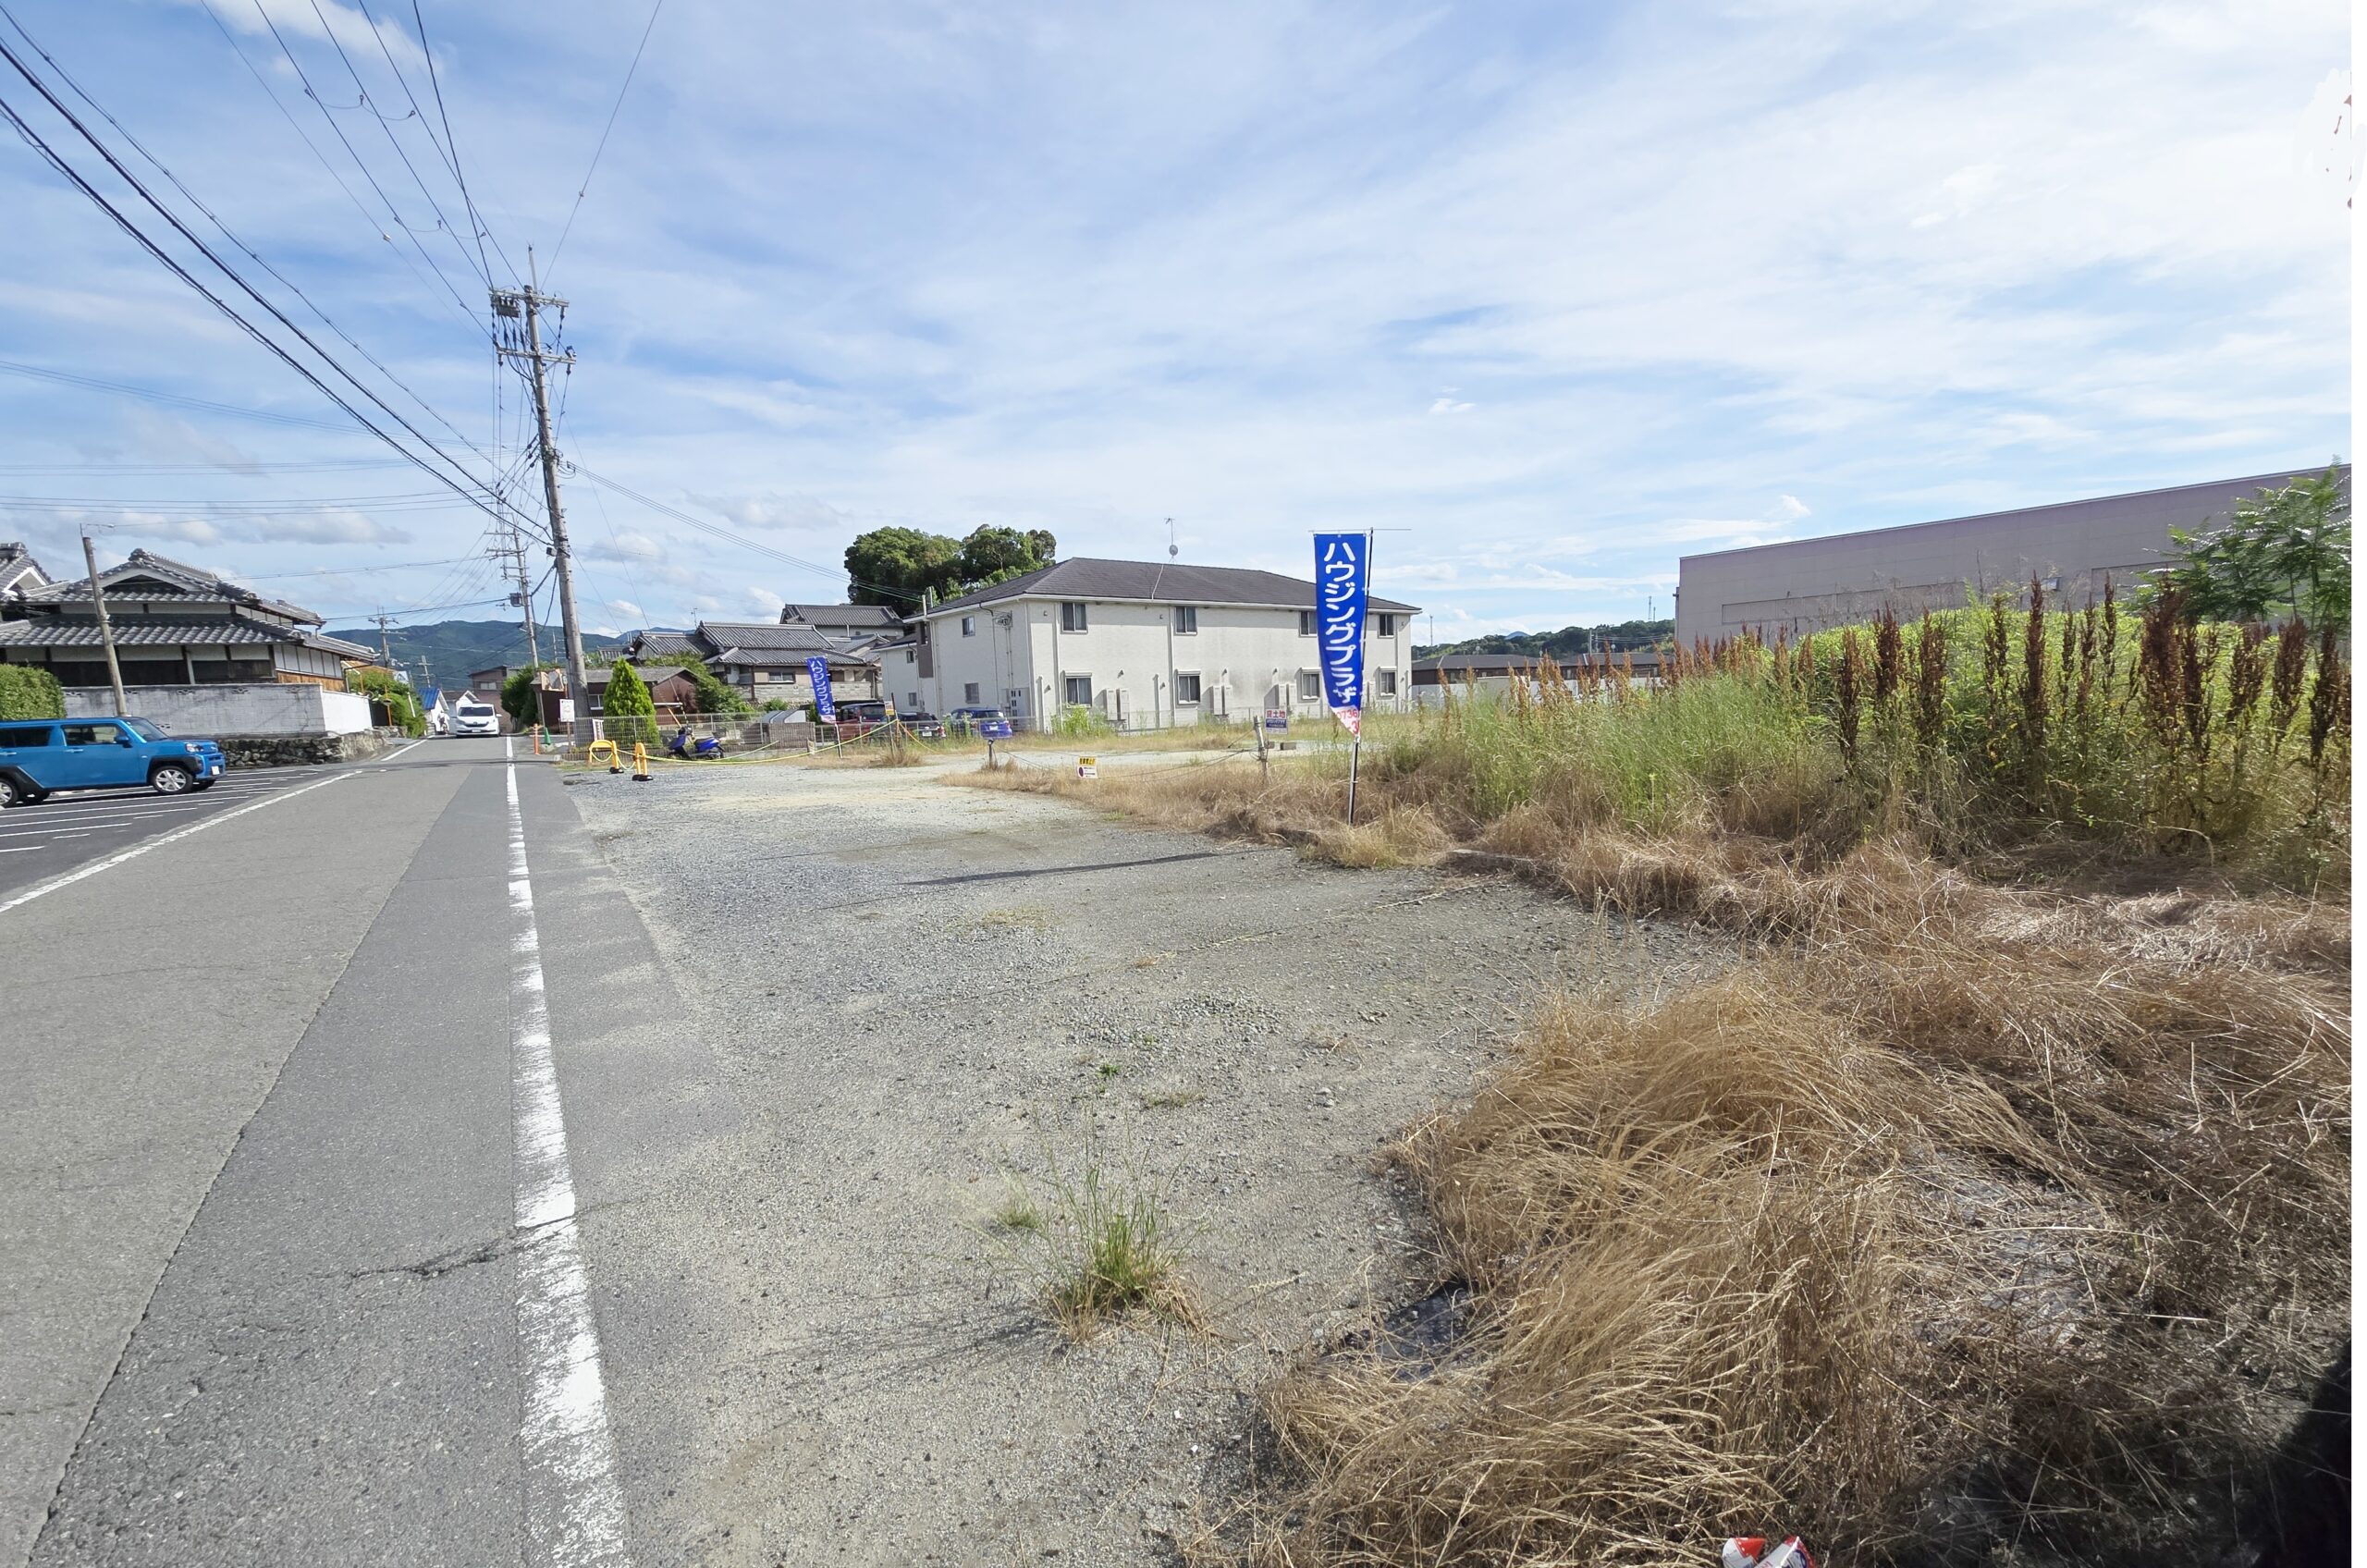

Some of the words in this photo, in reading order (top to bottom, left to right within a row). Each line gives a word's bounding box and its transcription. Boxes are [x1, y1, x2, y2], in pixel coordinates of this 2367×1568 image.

[1324, 542, 1357, 704] ハウジングプラザ
